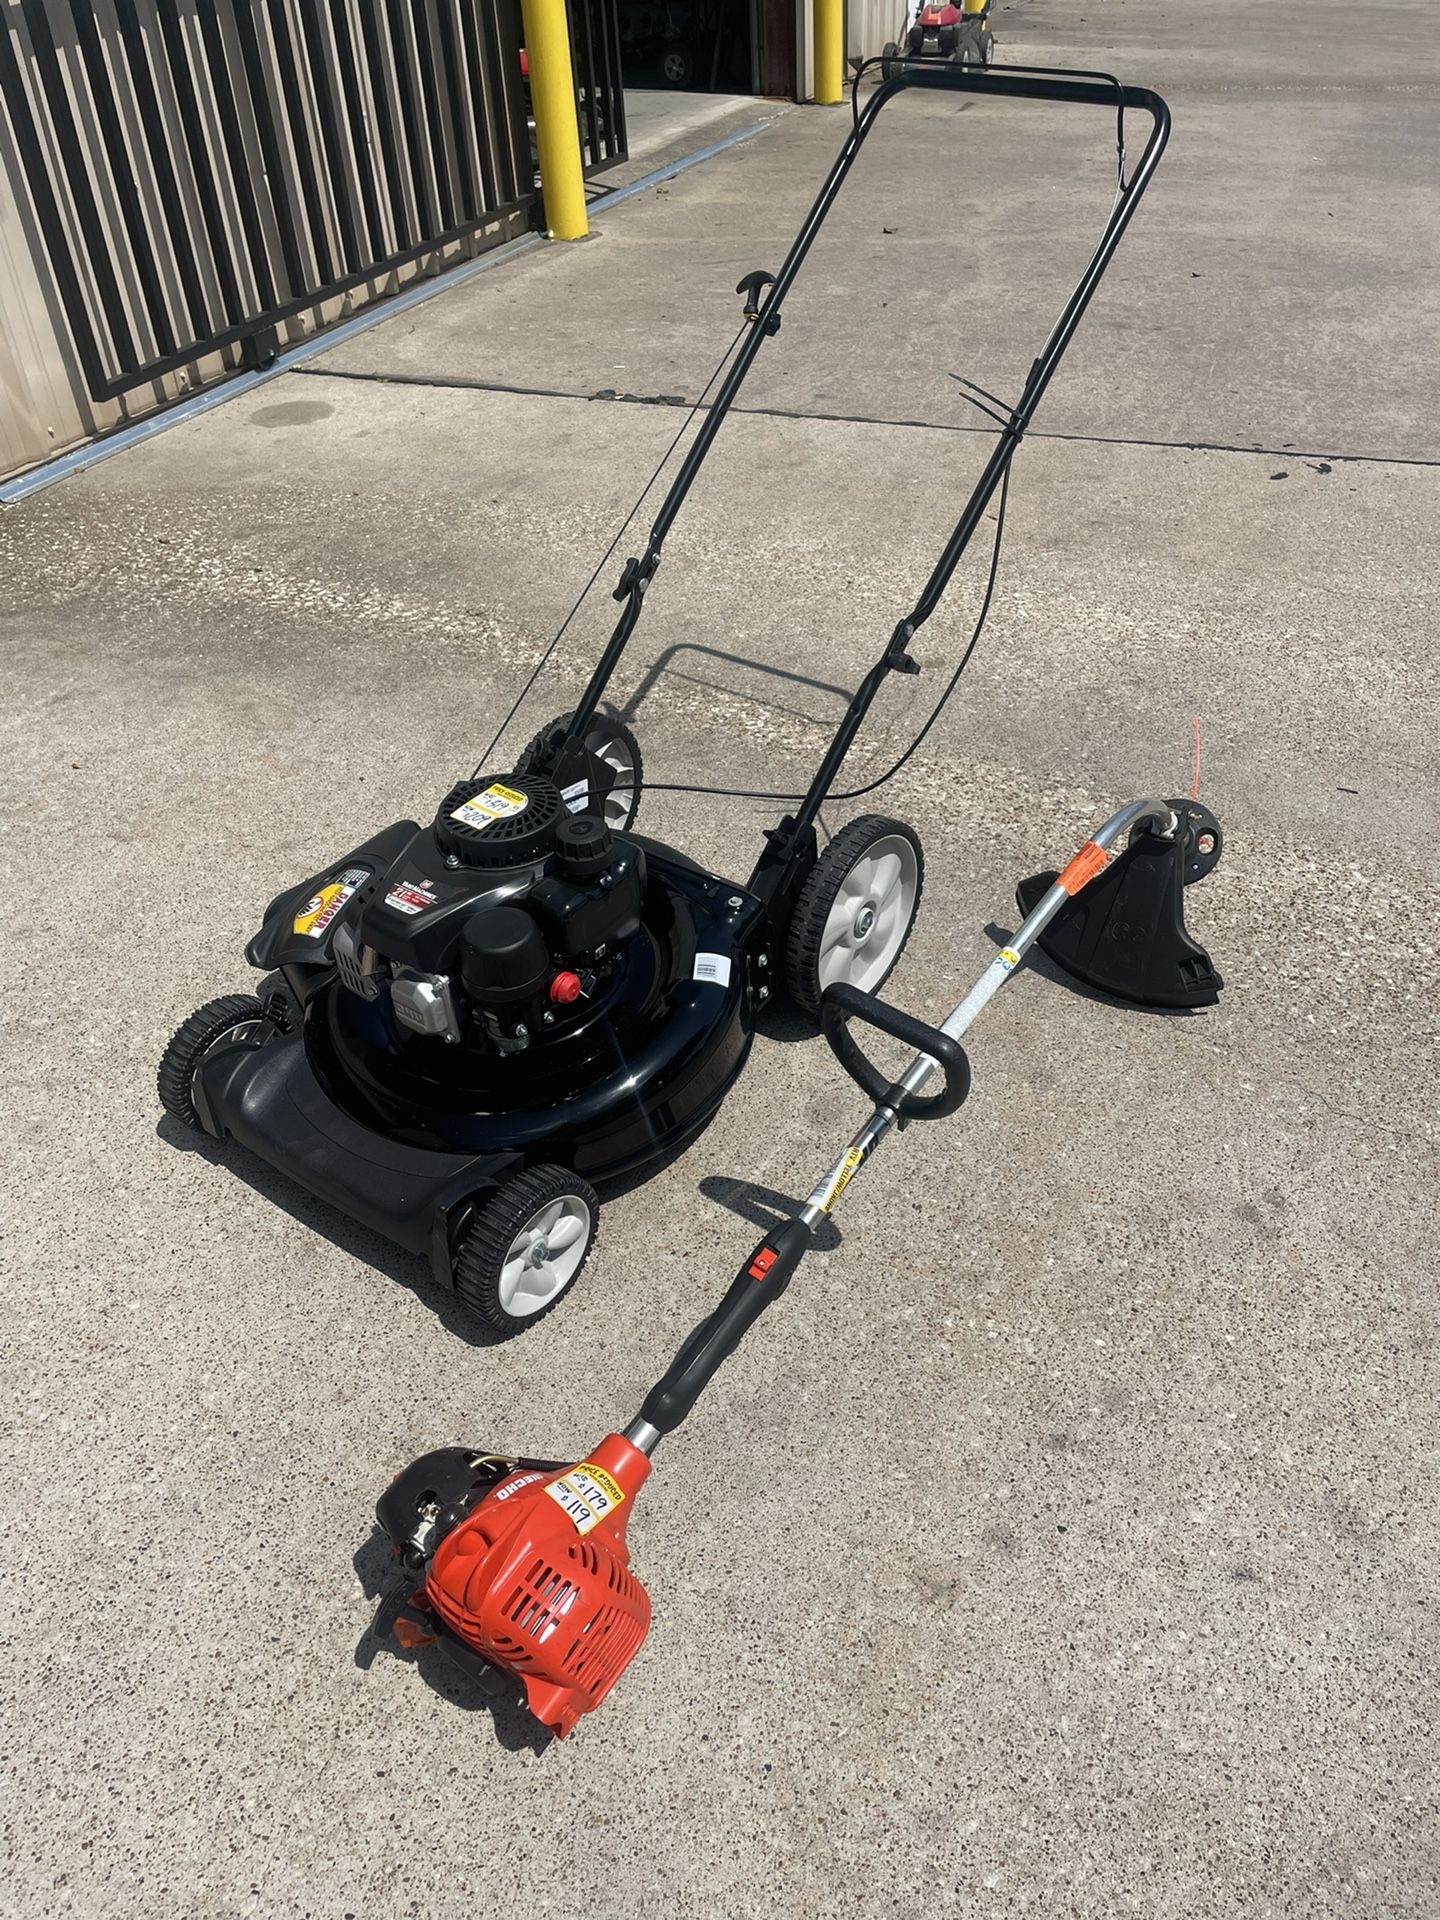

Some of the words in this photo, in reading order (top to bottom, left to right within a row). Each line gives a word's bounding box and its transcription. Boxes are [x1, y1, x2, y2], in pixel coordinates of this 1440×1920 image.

[315, 892, 349, 930] DANGER
[496, 1474, 535, 1501] ECHO
[558, 1482, 572, 1494] NOW
[580, 1464, 598, 1474] PRICE
[599, 1472, 622, 1500] REDUCED
